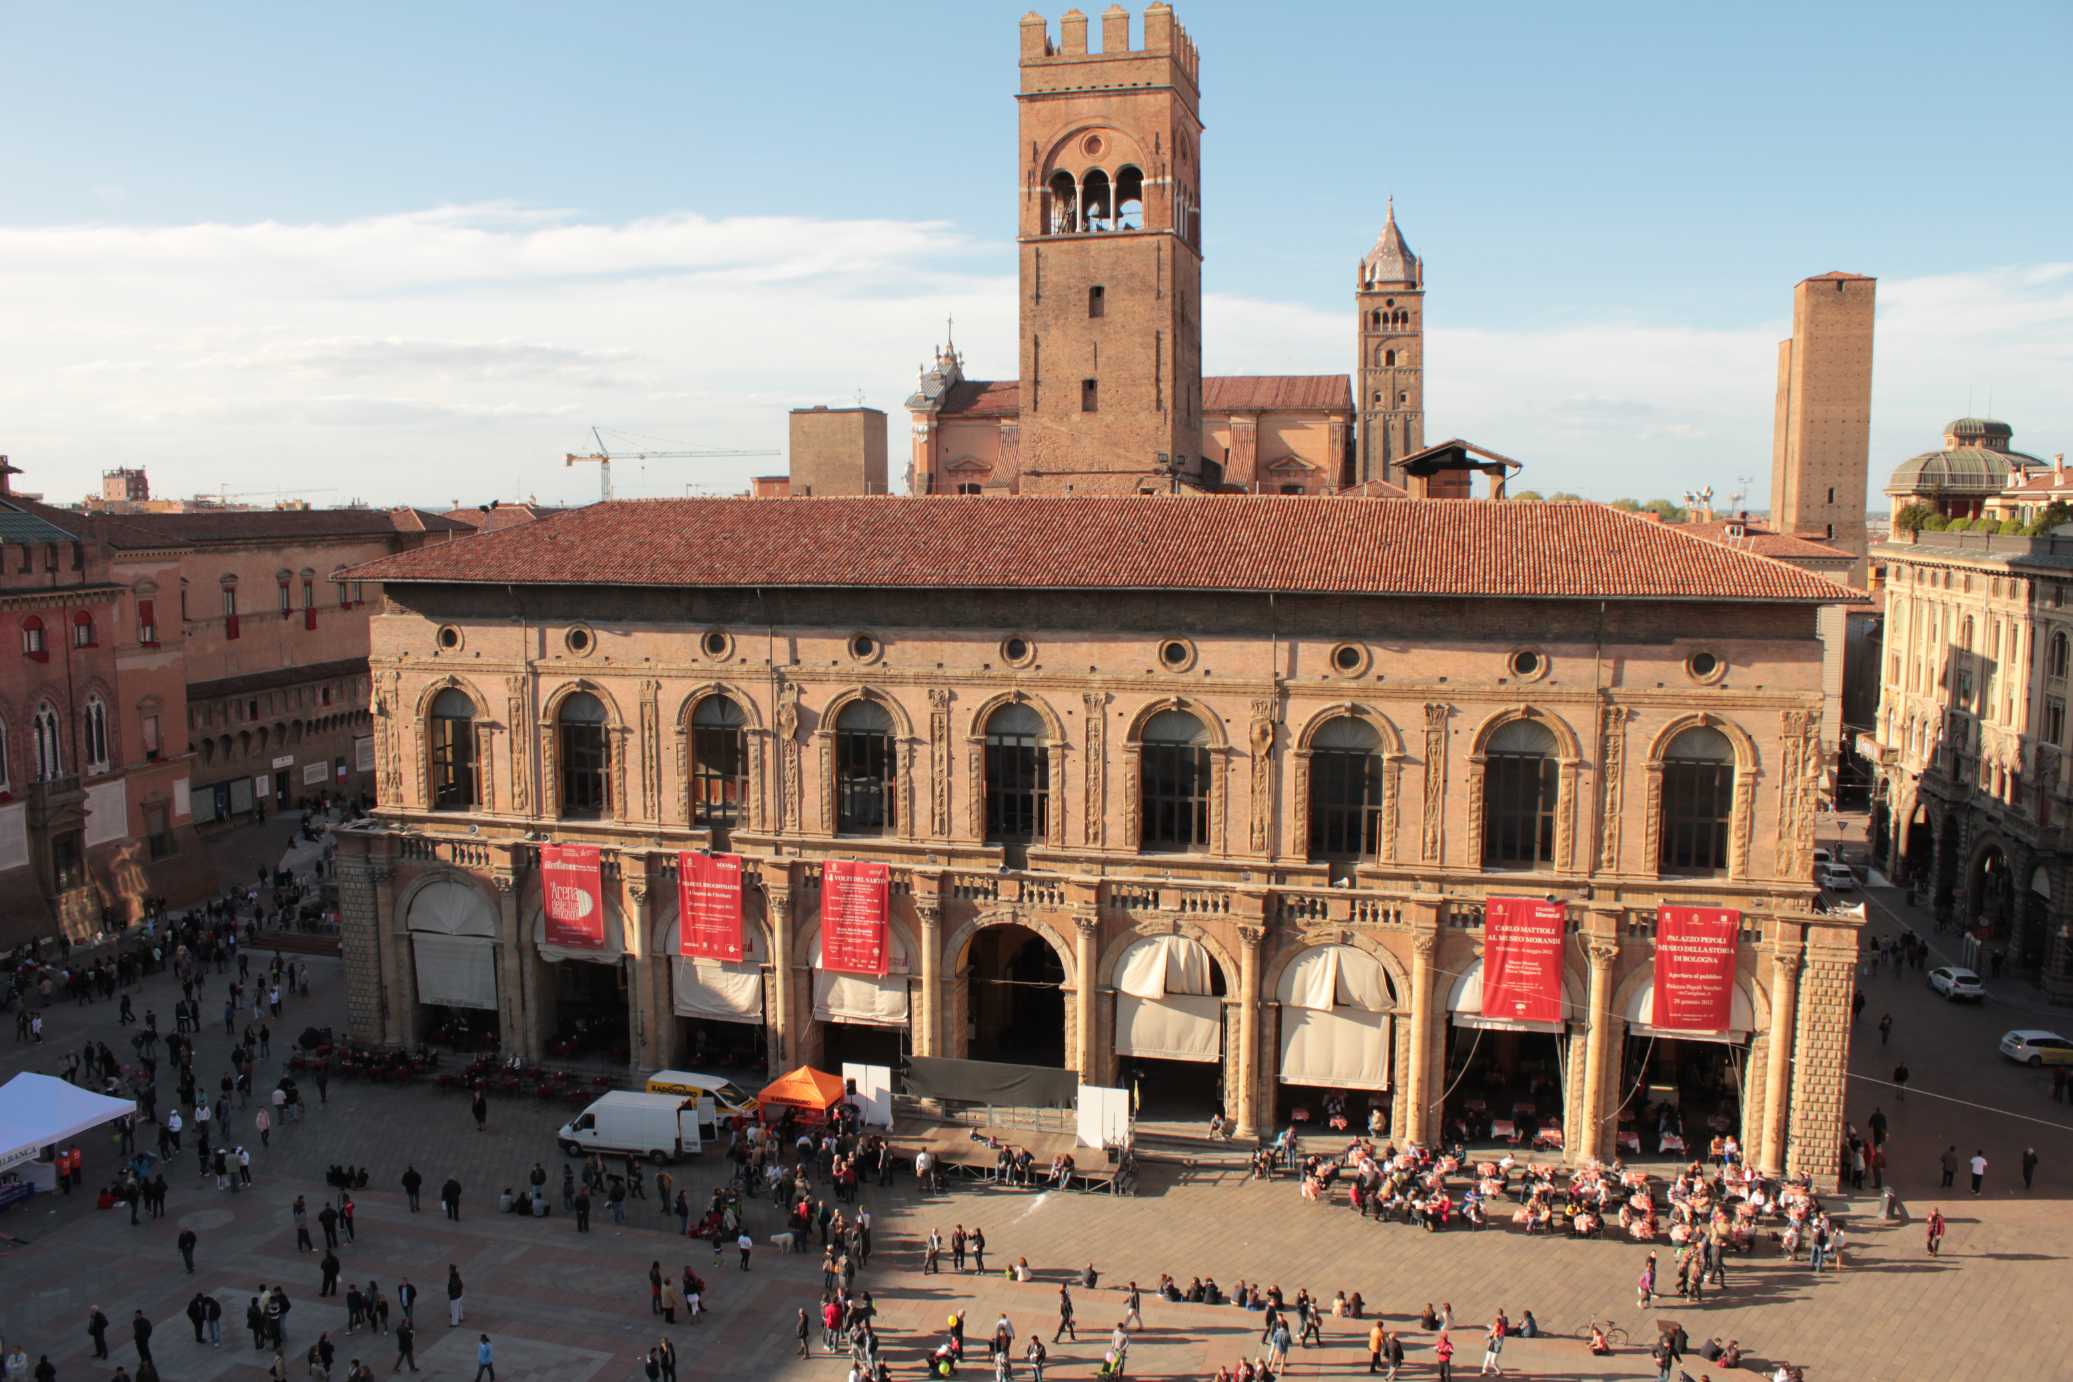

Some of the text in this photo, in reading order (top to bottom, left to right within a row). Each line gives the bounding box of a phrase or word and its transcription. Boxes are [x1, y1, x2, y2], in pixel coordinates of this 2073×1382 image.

[1495, 924, 1520, 932] CARLO
[1488, 934, 1561, 945] AL MUSEO MORANDI
[1667, 934, 1727, 944] PALAZZO PEPOLI
[1658, 944, 1684, 952] MUSEO
[1684, 946, 1708, 954] DELLA
[1682, 956, 1719, 965] BOLOGNA
